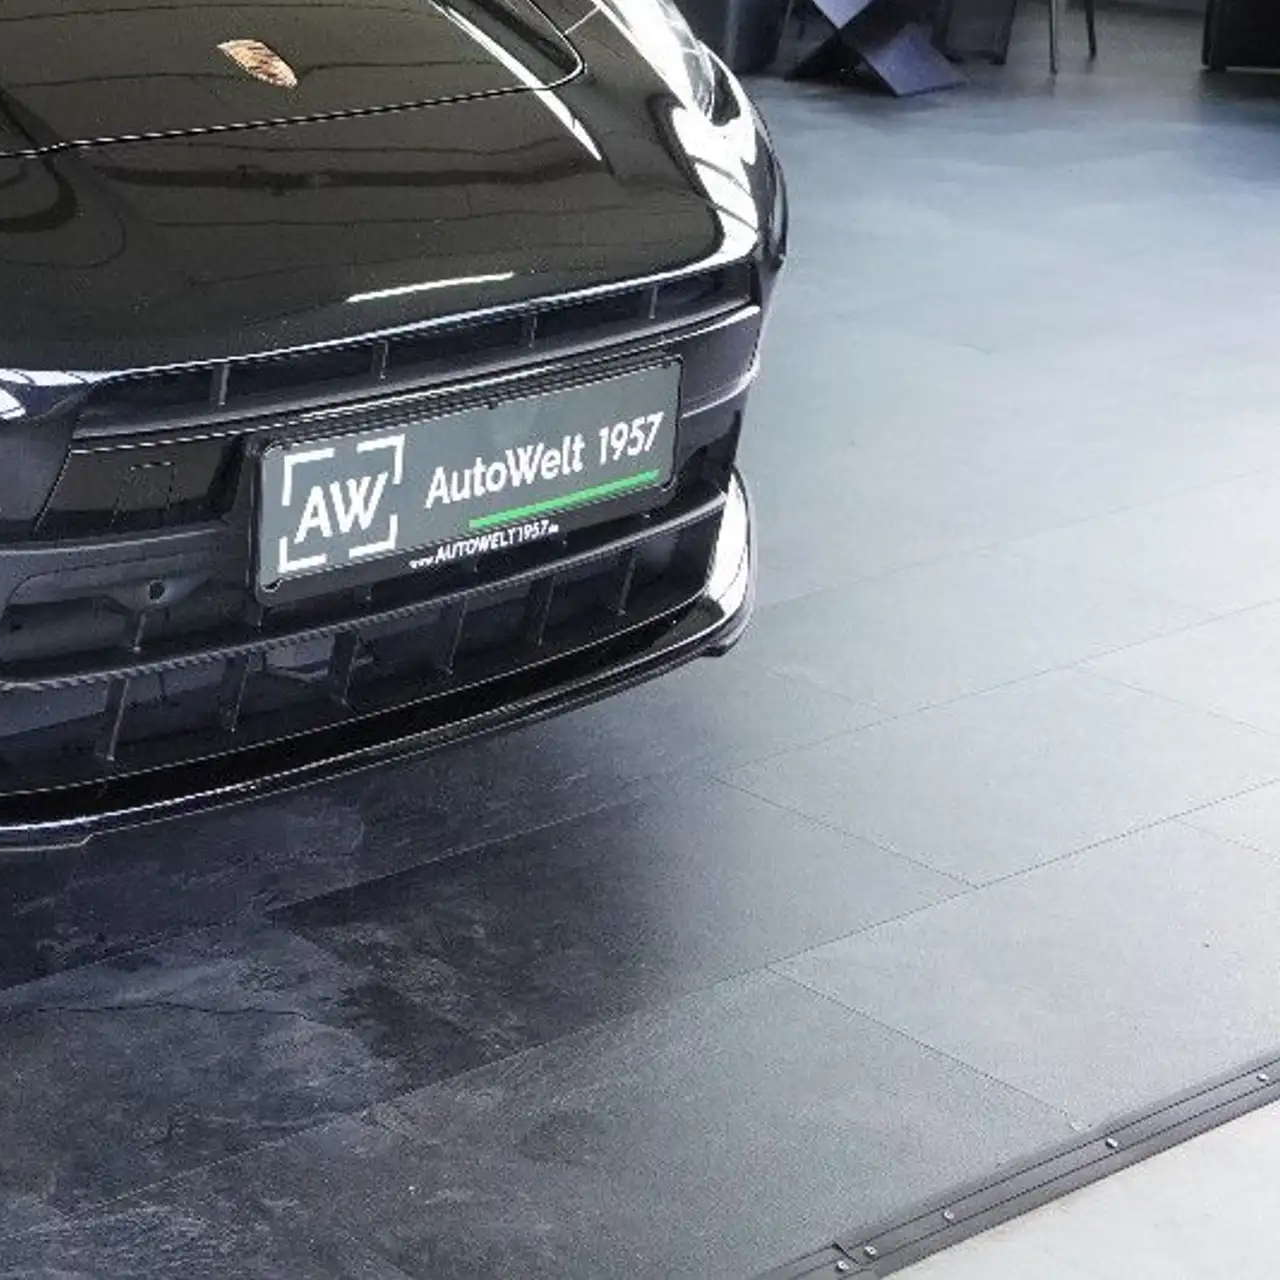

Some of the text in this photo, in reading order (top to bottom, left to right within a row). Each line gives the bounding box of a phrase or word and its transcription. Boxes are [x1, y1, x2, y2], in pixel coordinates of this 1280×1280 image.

[425, 412, 665, 509] AutoWelt 1957
[293, 471, 389, 545] AW
